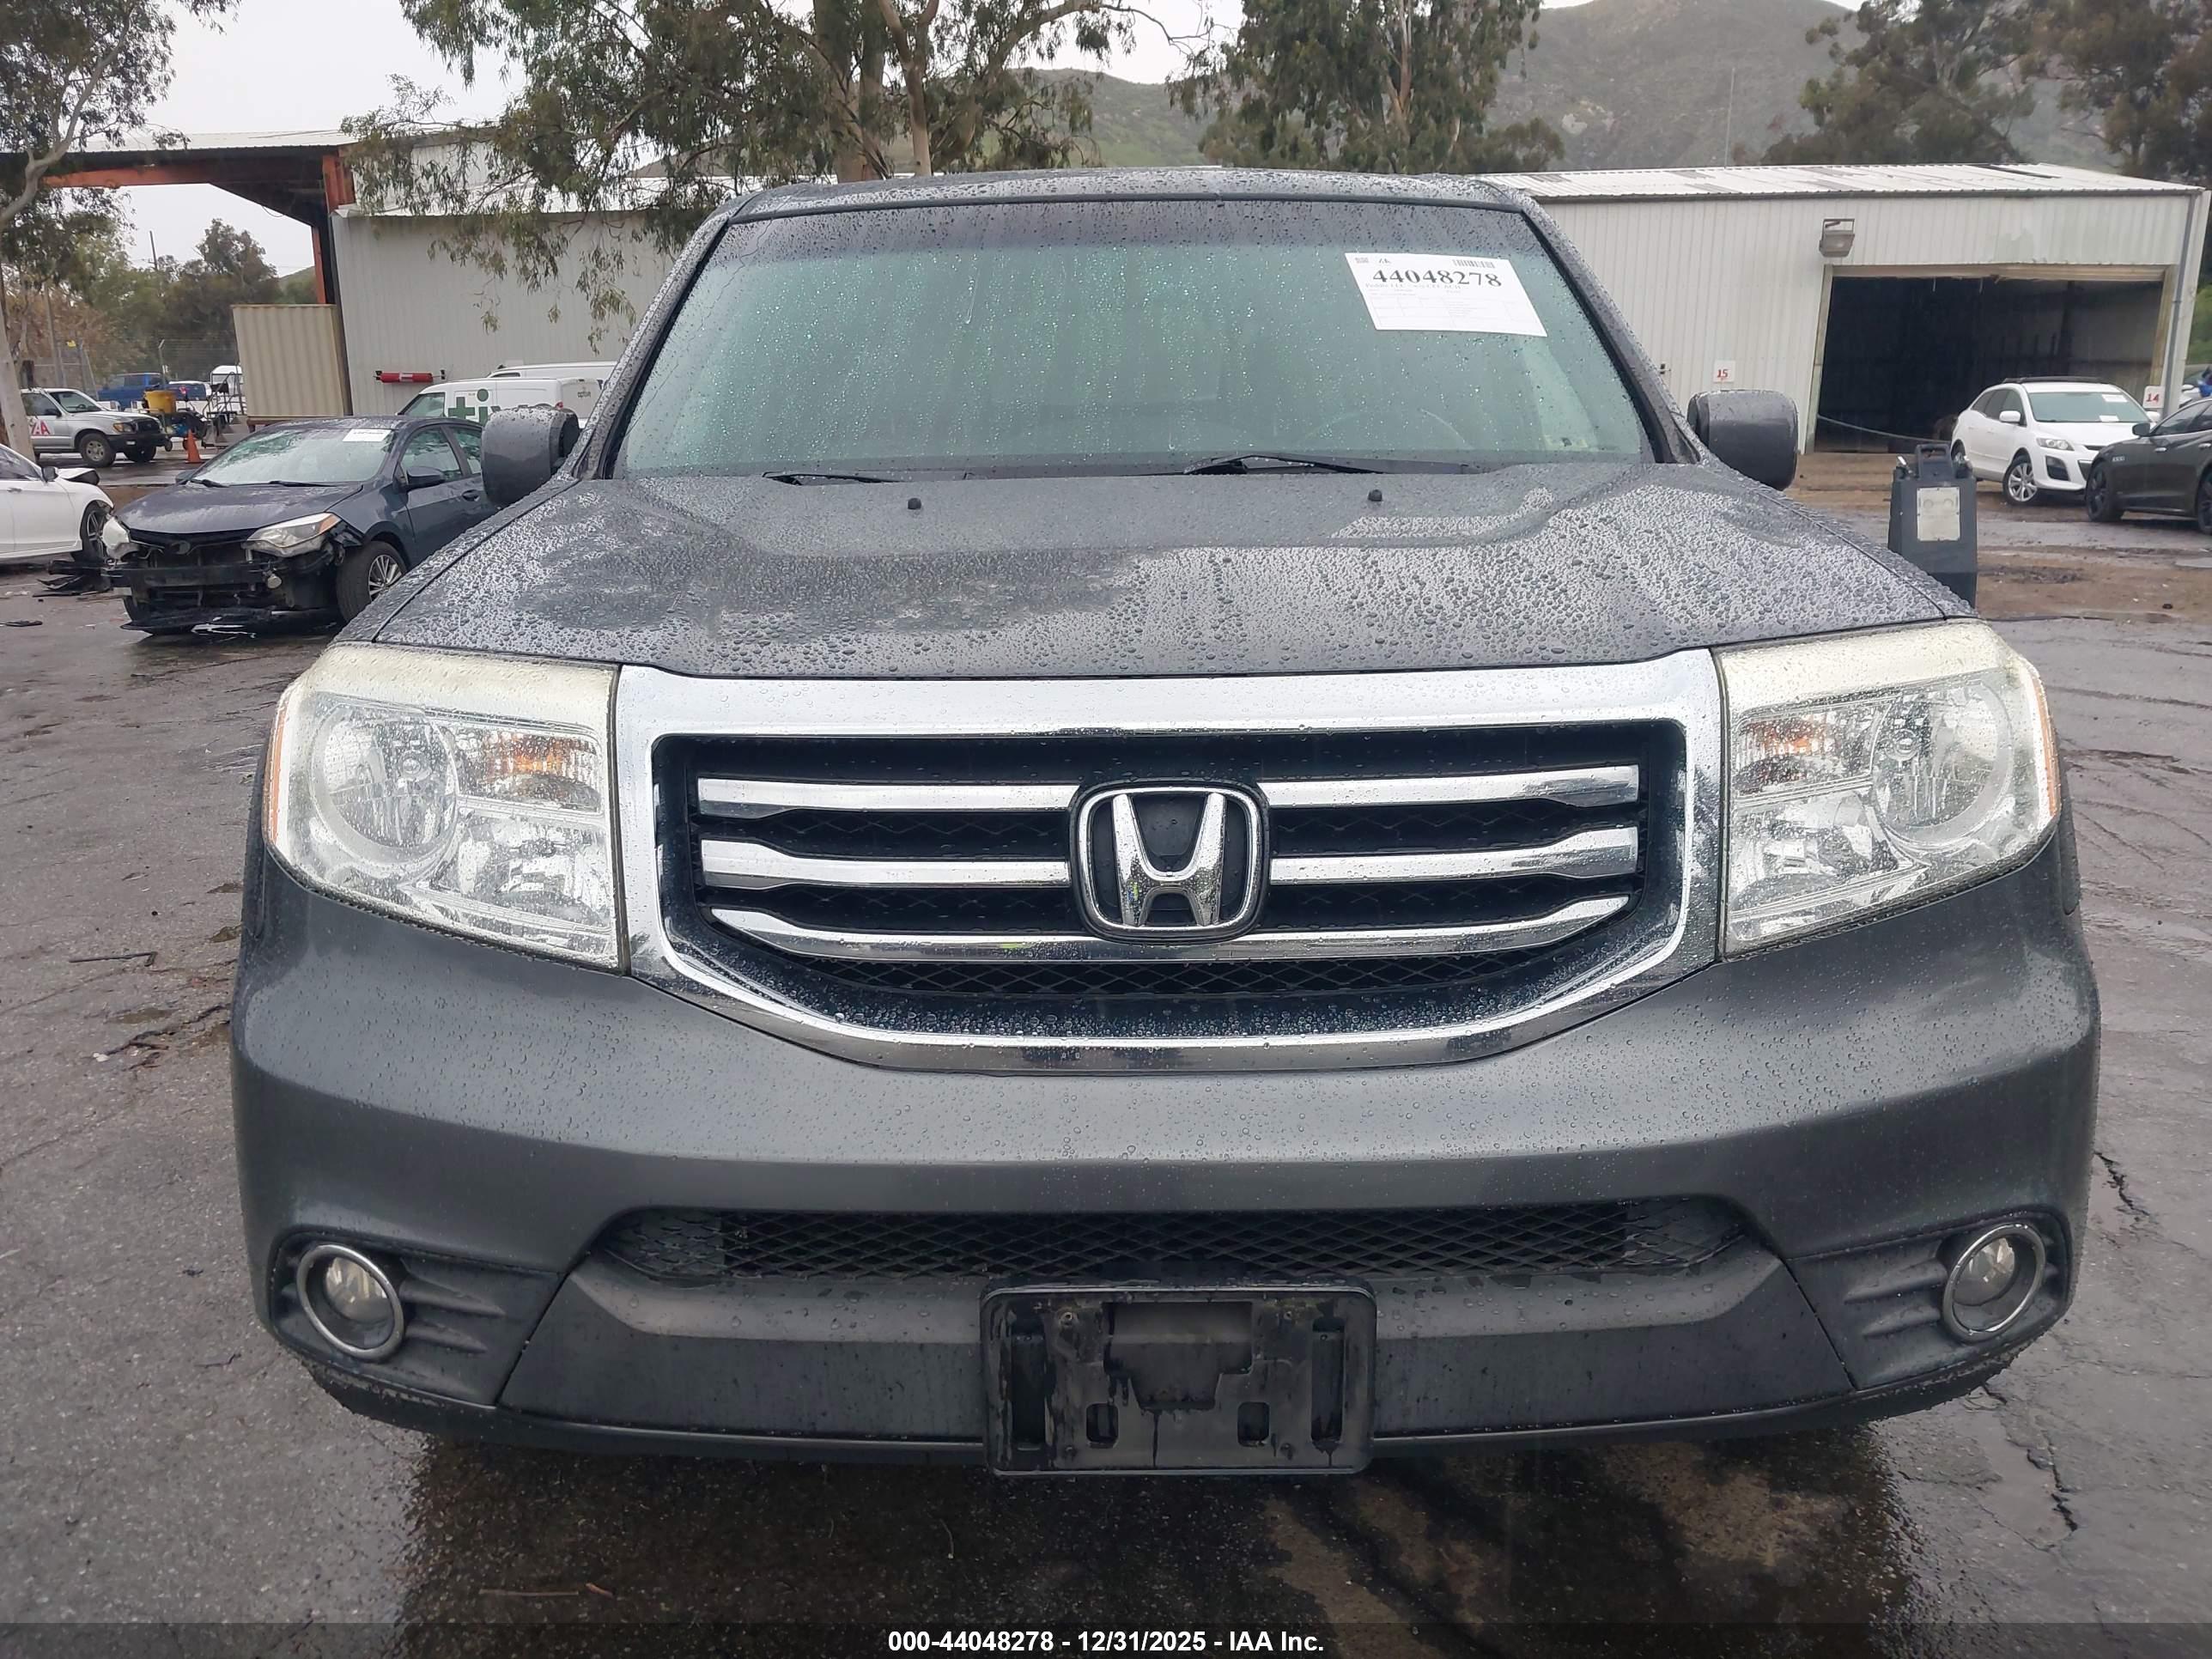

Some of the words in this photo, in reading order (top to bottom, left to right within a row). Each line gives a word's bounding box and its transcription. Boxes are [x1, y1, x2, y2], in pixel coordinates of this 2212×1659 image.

[1372, 269, 1503, 287] 44048278
[1717, 368, 1729, 378] 15
[2145, 392, 2159, 403] 14
